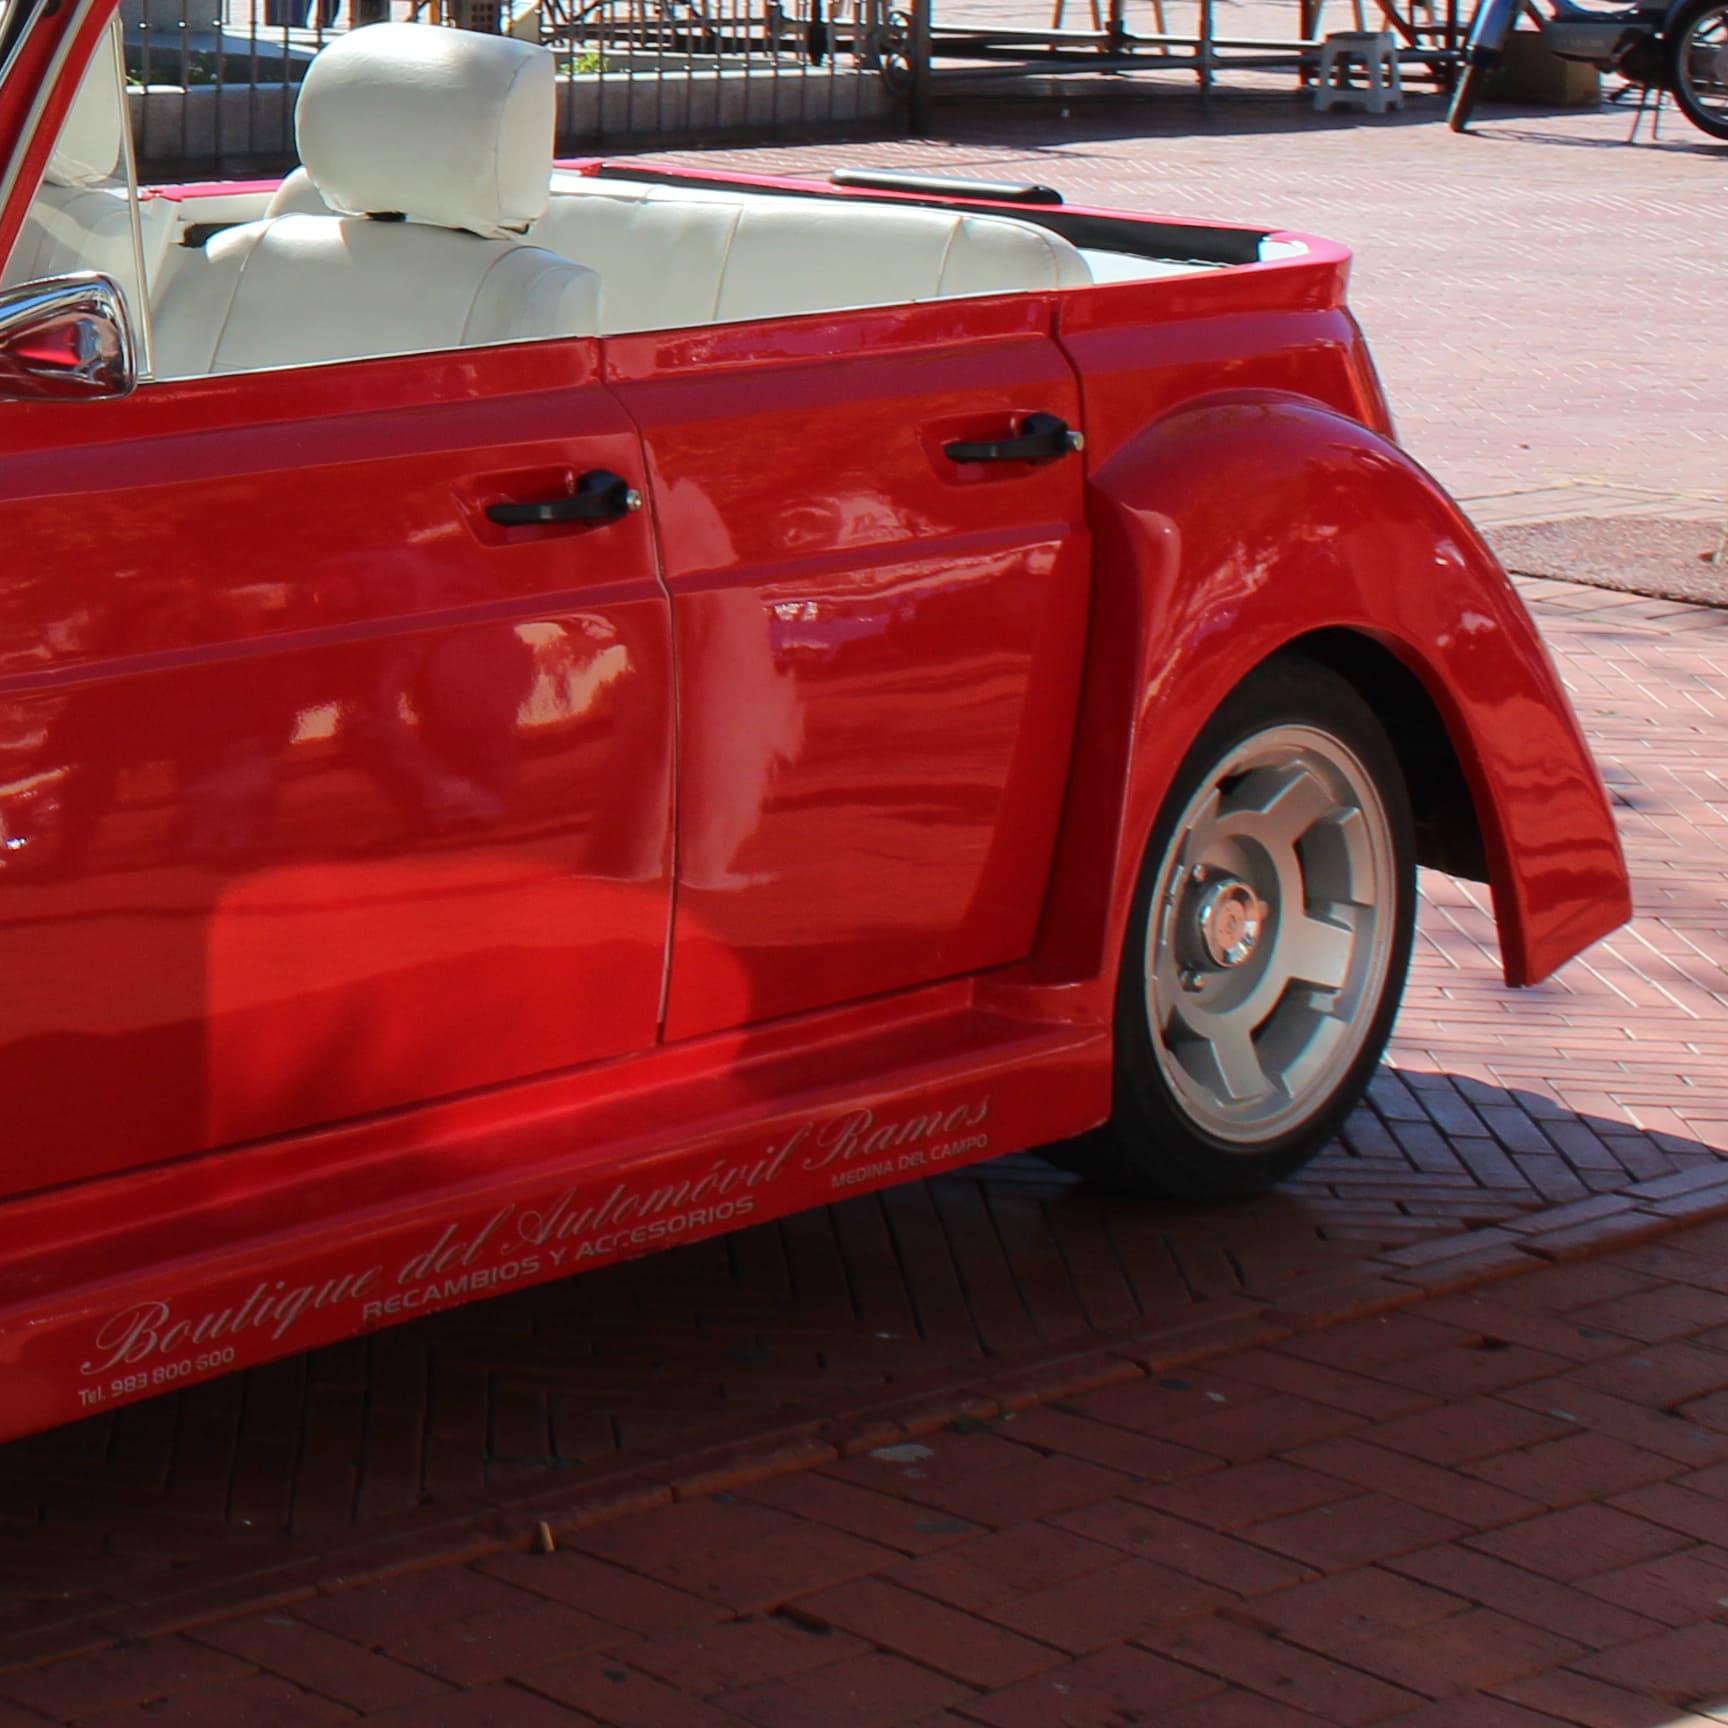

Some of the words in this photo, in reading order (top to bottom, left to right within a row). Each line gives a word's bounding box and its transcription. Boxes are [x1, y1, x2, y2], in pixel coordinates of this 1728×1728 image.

[831, 1160, 895, 1189] MEDINA
[898, 1151, 927, 1172] DEL
[930, 1133, 988, 1161] CAMPO
[79, 1265, 384, 1375] Boutique
[397, 1203, 517, 1286] del
[499, 1122, 815, 1256] Automóvil
[801, 1095, 992, 1170] Ramos
[362, 1255, 540, 1321] RECAMBIOS
[548, 1245, 568, 1267] Y
[78, 1385, 106, 1406] Tel.
[111, 1372, 148, 1398] 983
[152, 1358, 192, 1384] 800
